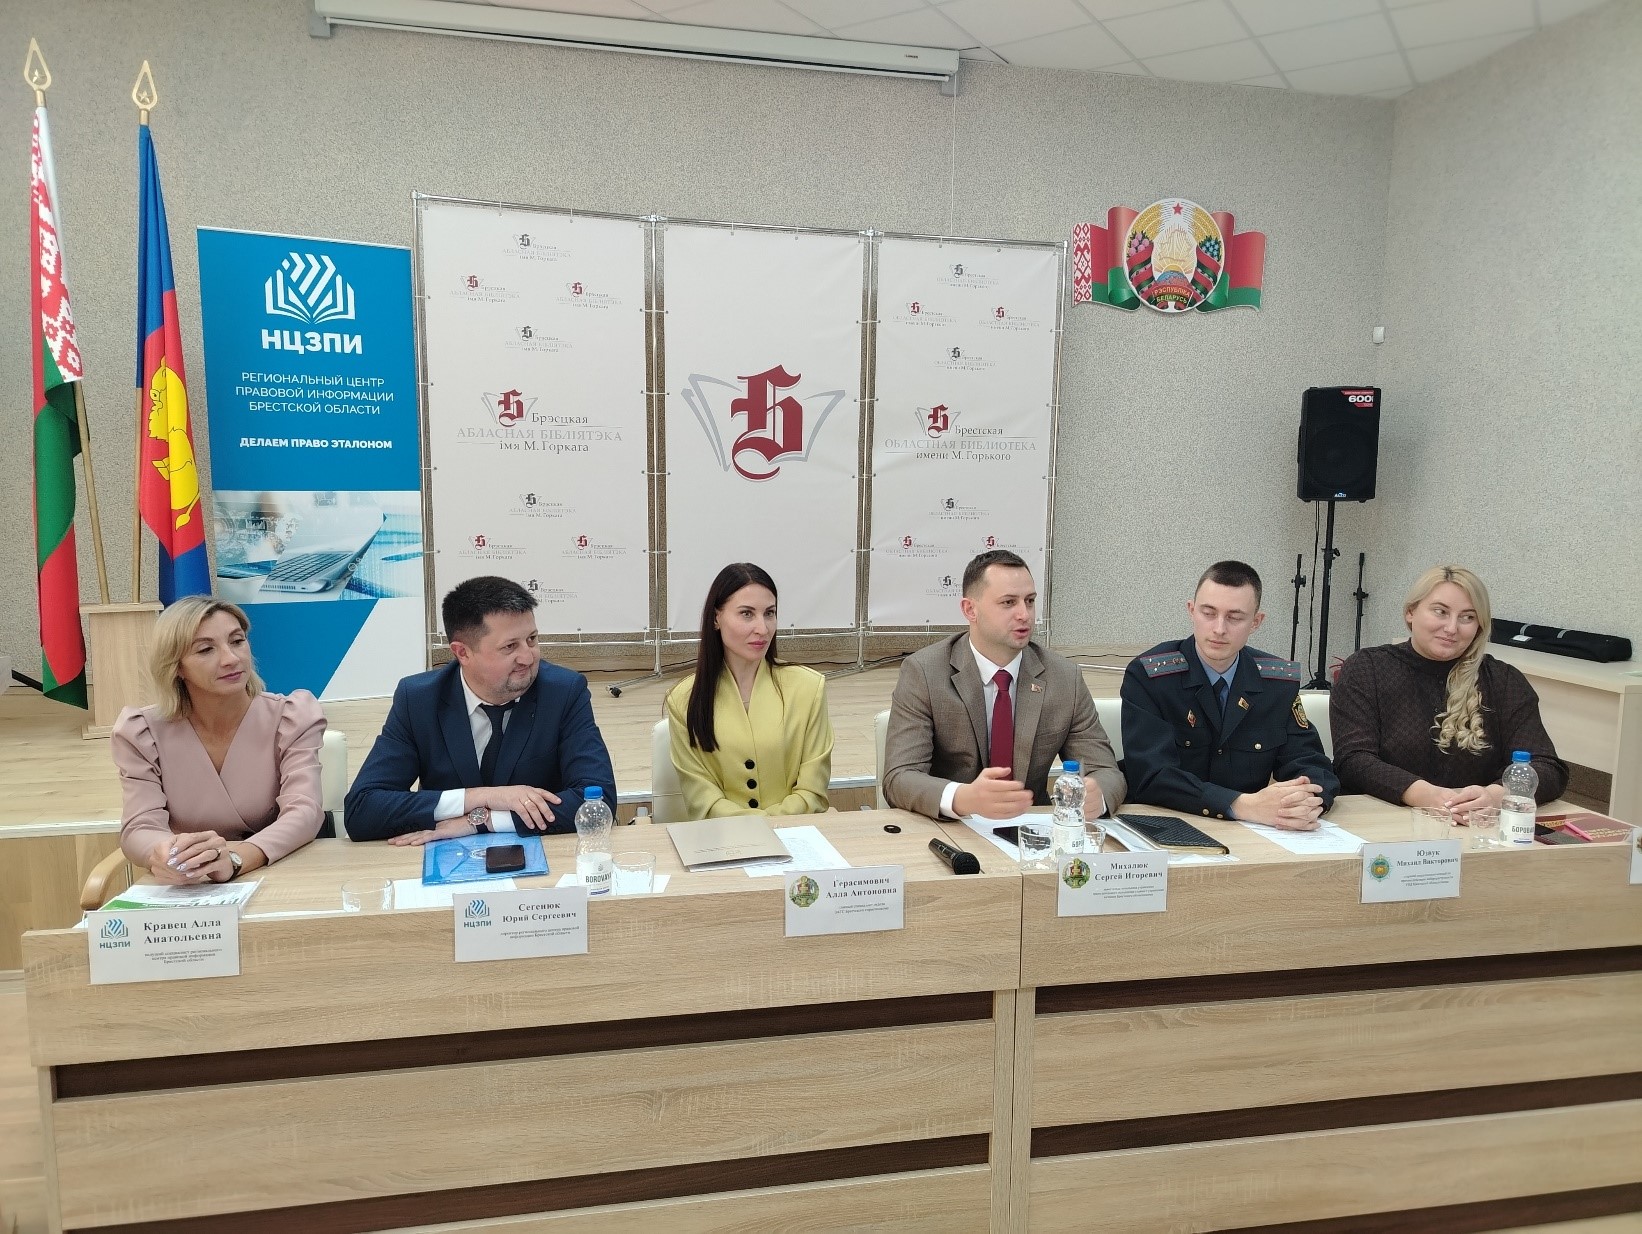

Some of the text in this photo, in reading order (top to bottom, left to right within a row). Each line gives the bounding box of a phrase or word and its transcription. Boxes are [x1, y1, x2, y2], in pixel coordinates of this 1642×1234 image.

[1156, 294, 1187, 304] БЕЛАРУСЬ
[262, 329, 362, 354] НЦЗПИ
[242, 372, 385, 388] РЕГИОНАЛЬНЫЙ ЦЕНТР
[236, 387, 394, 402] ПРАВОВОЙ ИНФОРМАЦИИ
[249, 402, 380, 415] БРЕСТСКОЙ ОБЛАСТИ
[532, 412, 588, 425] Брэсцкая
[457, 428, 622, 441] АБЛАСНАЯ БІБЛІЯТЭКА
[955, 425, 1003, 436] Брестская
[240, 437, 392, 449] ДЕЛАЕМ ПРАВО ЭТАЛОНОМ
[500, 441, 589, 454] імя М. Горкага
[885, 438, 1036, 451] ОБЛАСТНАЯ БИБЛИОТЕКА
[916, 451, 1011, 462] имени М. Горького
[1111, 862, 1148, 870] Михалюк
[1095, 872, 1163, 881] Сергей Игоревич
[833, 878, 890, 889] Герасимович
[826, 887, 897, 899] Алла Антоновна
[518, 902, 561, 911] Сегенюк
[502, 912, 577, 924] Юрий Сергеевич
[144, 920, 221, 932] Кравец Алла
[144, 933, 222, 944] Анатольевна
[100, 941, 130, 949] НЦЗПИ
